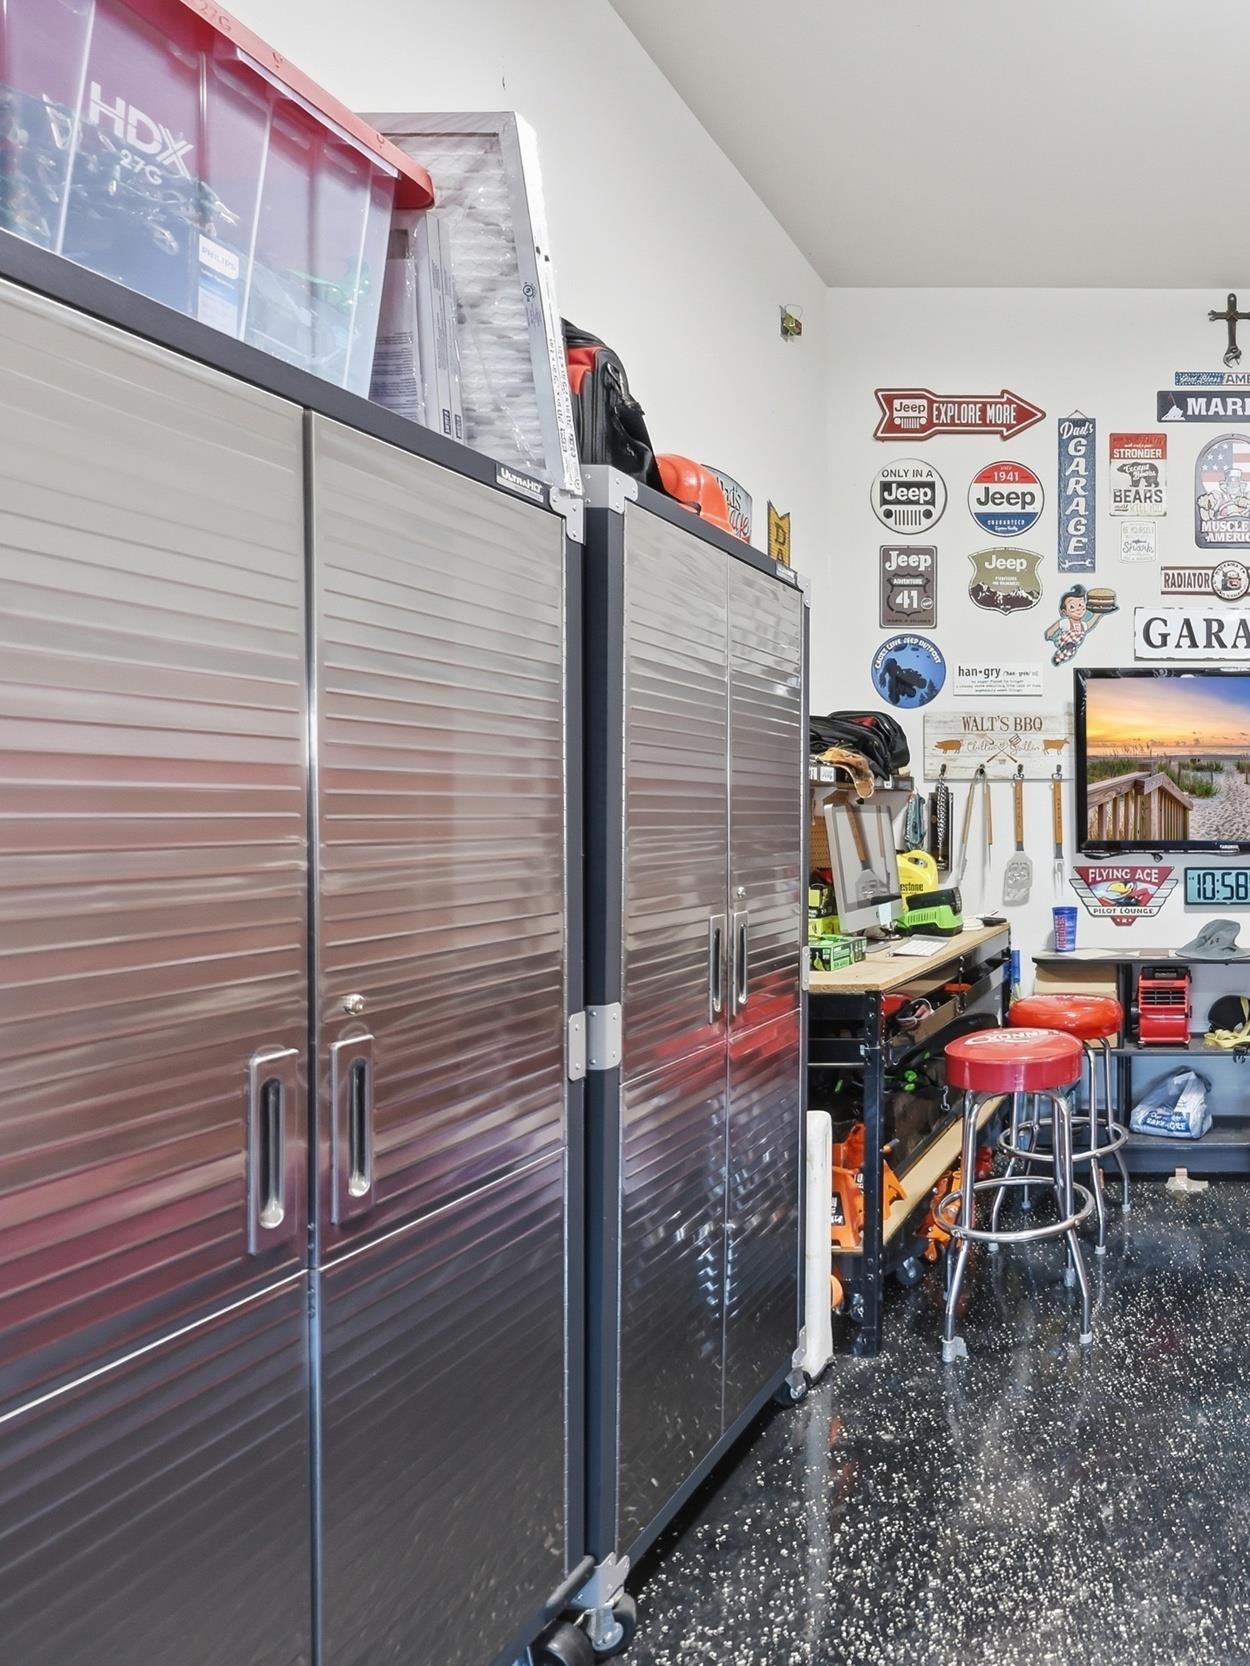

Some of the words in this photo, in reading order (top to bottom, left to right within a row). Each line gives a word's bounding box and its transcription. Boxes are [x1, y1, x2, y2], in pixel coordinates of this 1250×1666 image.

[89, 80, 194, 181] HDX
[119, 149, 163, 185] 27G
[895, 401, 926, 416] Jeep
[933, 403, 982, 424] EXPLORE
[987, 404, 1018, 425] MORE
[882, 469, 909, 482] ONLY
[912, 469, 921, 482] IN
[926, 469, 934, 482] A
[993, 472, 1020, 482] 1941
[884, 482, 932, 505] Jeep
[976, 486, 1036, 510] Jeep
[1064, 437, 1090, 556] GARAGE
[1113, 489, 1163, 503] BEARS
[1201, 520, 1249, 532] MUSCLE
[885, 550, 932, 571] Jeep
[984, 554, 1028, 573] Jeep
[1163, 573, 1211, 590] RADIATOR
[895, 590, 919, 609] 41
[918, 638, 942, 664] OUTPOST
[962, 716, 1009, 732] WALT'S
[1013, 716, 1043, 732] BBQ
[1088, 867, 1132, 883] FLYING
[1136, 869, 1159, 882] ACE
[1197, 871, 1249, 901] 10:58
[1119, 907, 1155, 915] LOUNGE
